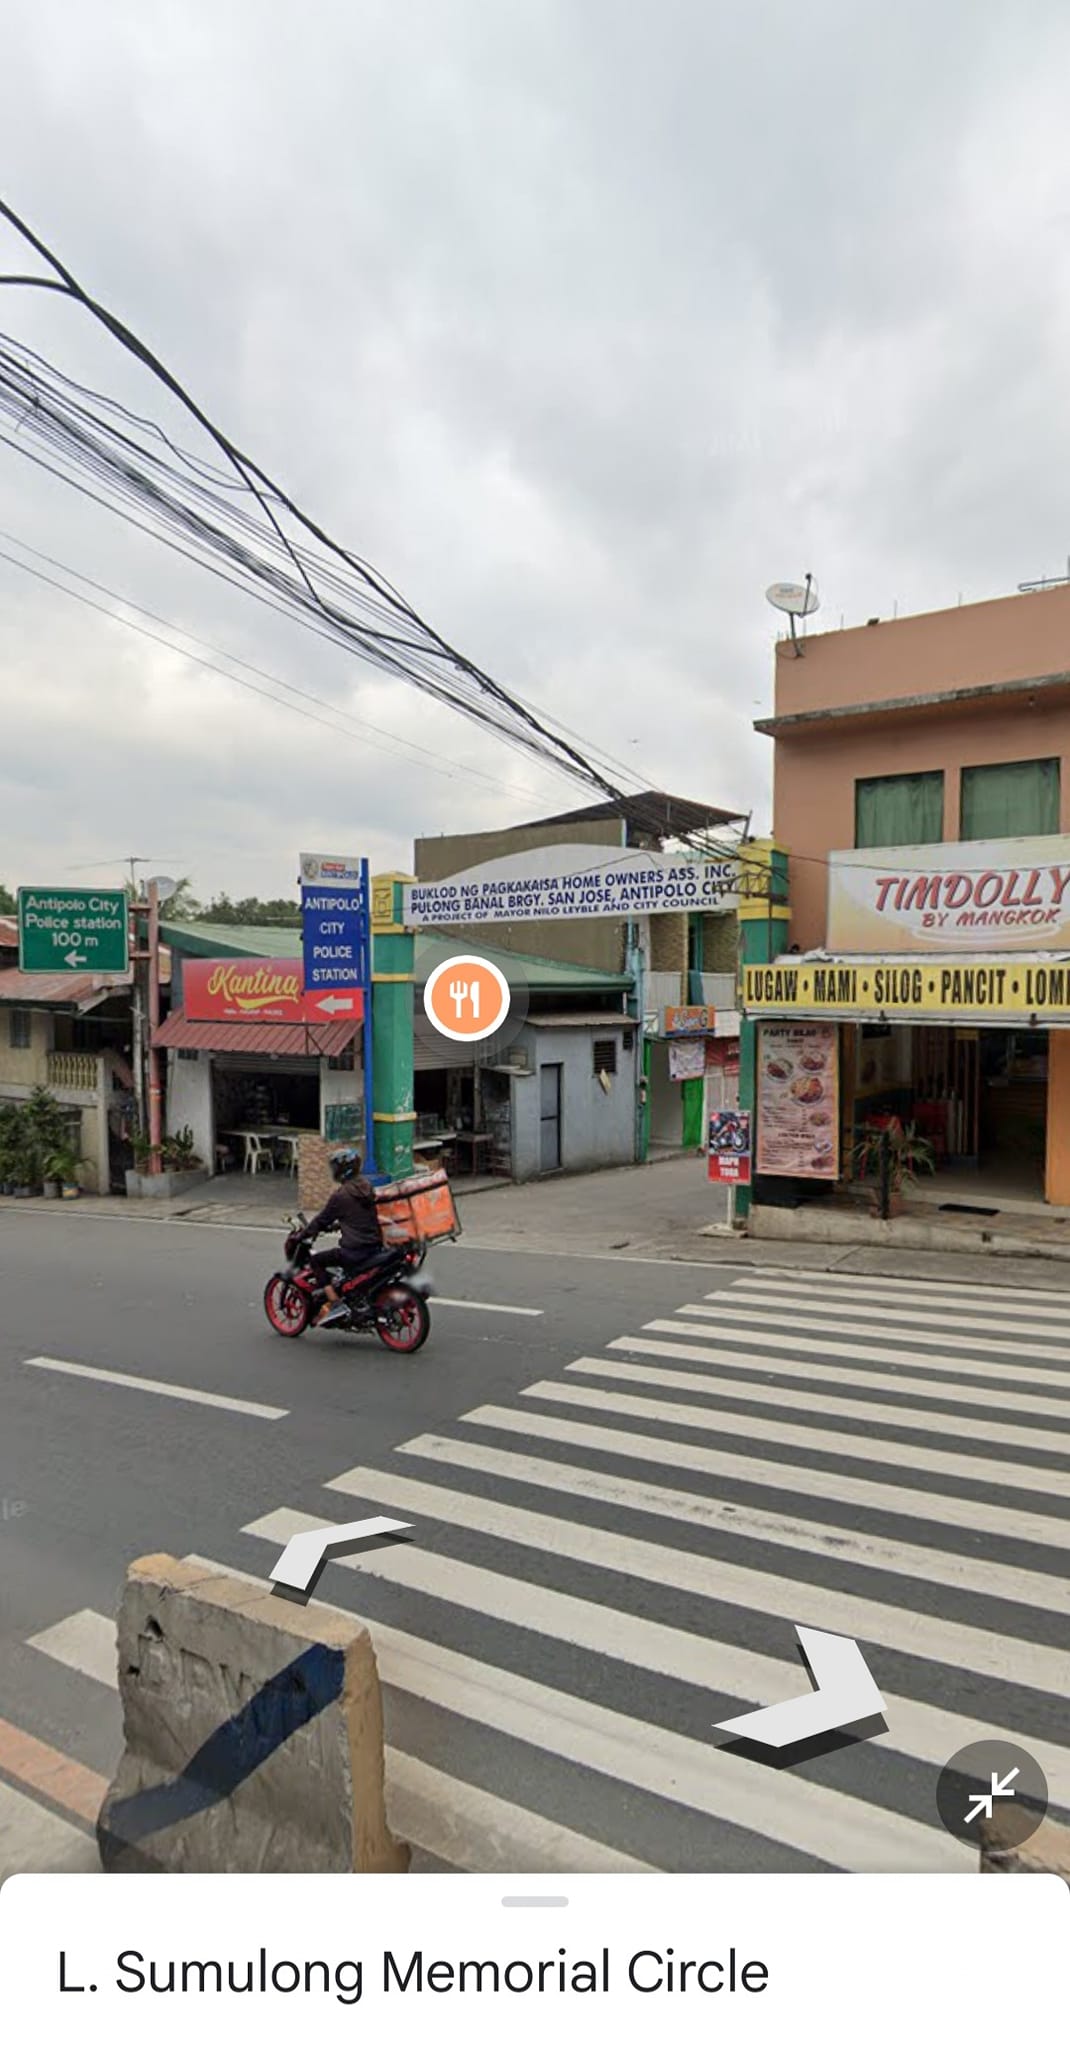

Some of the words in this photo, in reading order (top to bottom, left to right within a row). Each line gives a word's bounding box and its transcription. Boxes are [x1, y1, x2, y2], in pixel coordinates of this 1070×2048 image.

[411, 886, 457, 900] BUKLOD
[460, 885, 478, 897] NG
[482, 878, 558, 895] PAGKAKAISA
[562, 875, 601, 889] HOME
[605, 870, 664, 886] OWNERS
[668, 867, 699, 881] ASS.
[705, 864, 737, 879] INC.
[875, 866, 1070, 912] TIMDOLLY
[26, 895, 87, 914] Antipolo
[88, 897, 119, 916] City
[305, 897, 360, 911] ANTIPOLO
[411, 900, 460, 914] PULONG
[464, 897, 505, 911] BANAL
[508, 894, 544, 908] BRGY.
[548, 892, 575, 905] SAN
[579, 889, 616, 904] JOSE,
[620, 882, 696, 900] ANTIPOLO
[702, 880, 734, 895] CITY
[422, 914, 429, 922] A
[432, 913, 472, 922] PROJECT
[475, 911, 488, 920] OF
[493, 909, 530, 918] MAYOR
[533, 907, 560, 916] NILO
[562, 904, 600, 914] LEYBLE
[603, 902, 630, 912] AND
[633, 901, 658, 910] CITY
[664, 897, 719, 909] COUNCIL
[922, 913, 949, 927] BY
[956, 908, 1061, 927] MANGKOK
[25, 913, 69, 929] Police
[73, 917, 122, 929] station
[320, 921, 345, 935] CITY
[52, 932, 82, 947] 100
[84, 937, 99, 947] m
[313, 945, 353, 959] POLICE
[208, 965, 299, 1004] Kantina
[312, 968, 358, 981] STATION
[747, 969, 798, 1001] LUGAW
[813, 969, 857, 1002] MAMI
[874, 969, 922, 1003] SILOG
[941, 969, 1006, 1004] PANCIT
